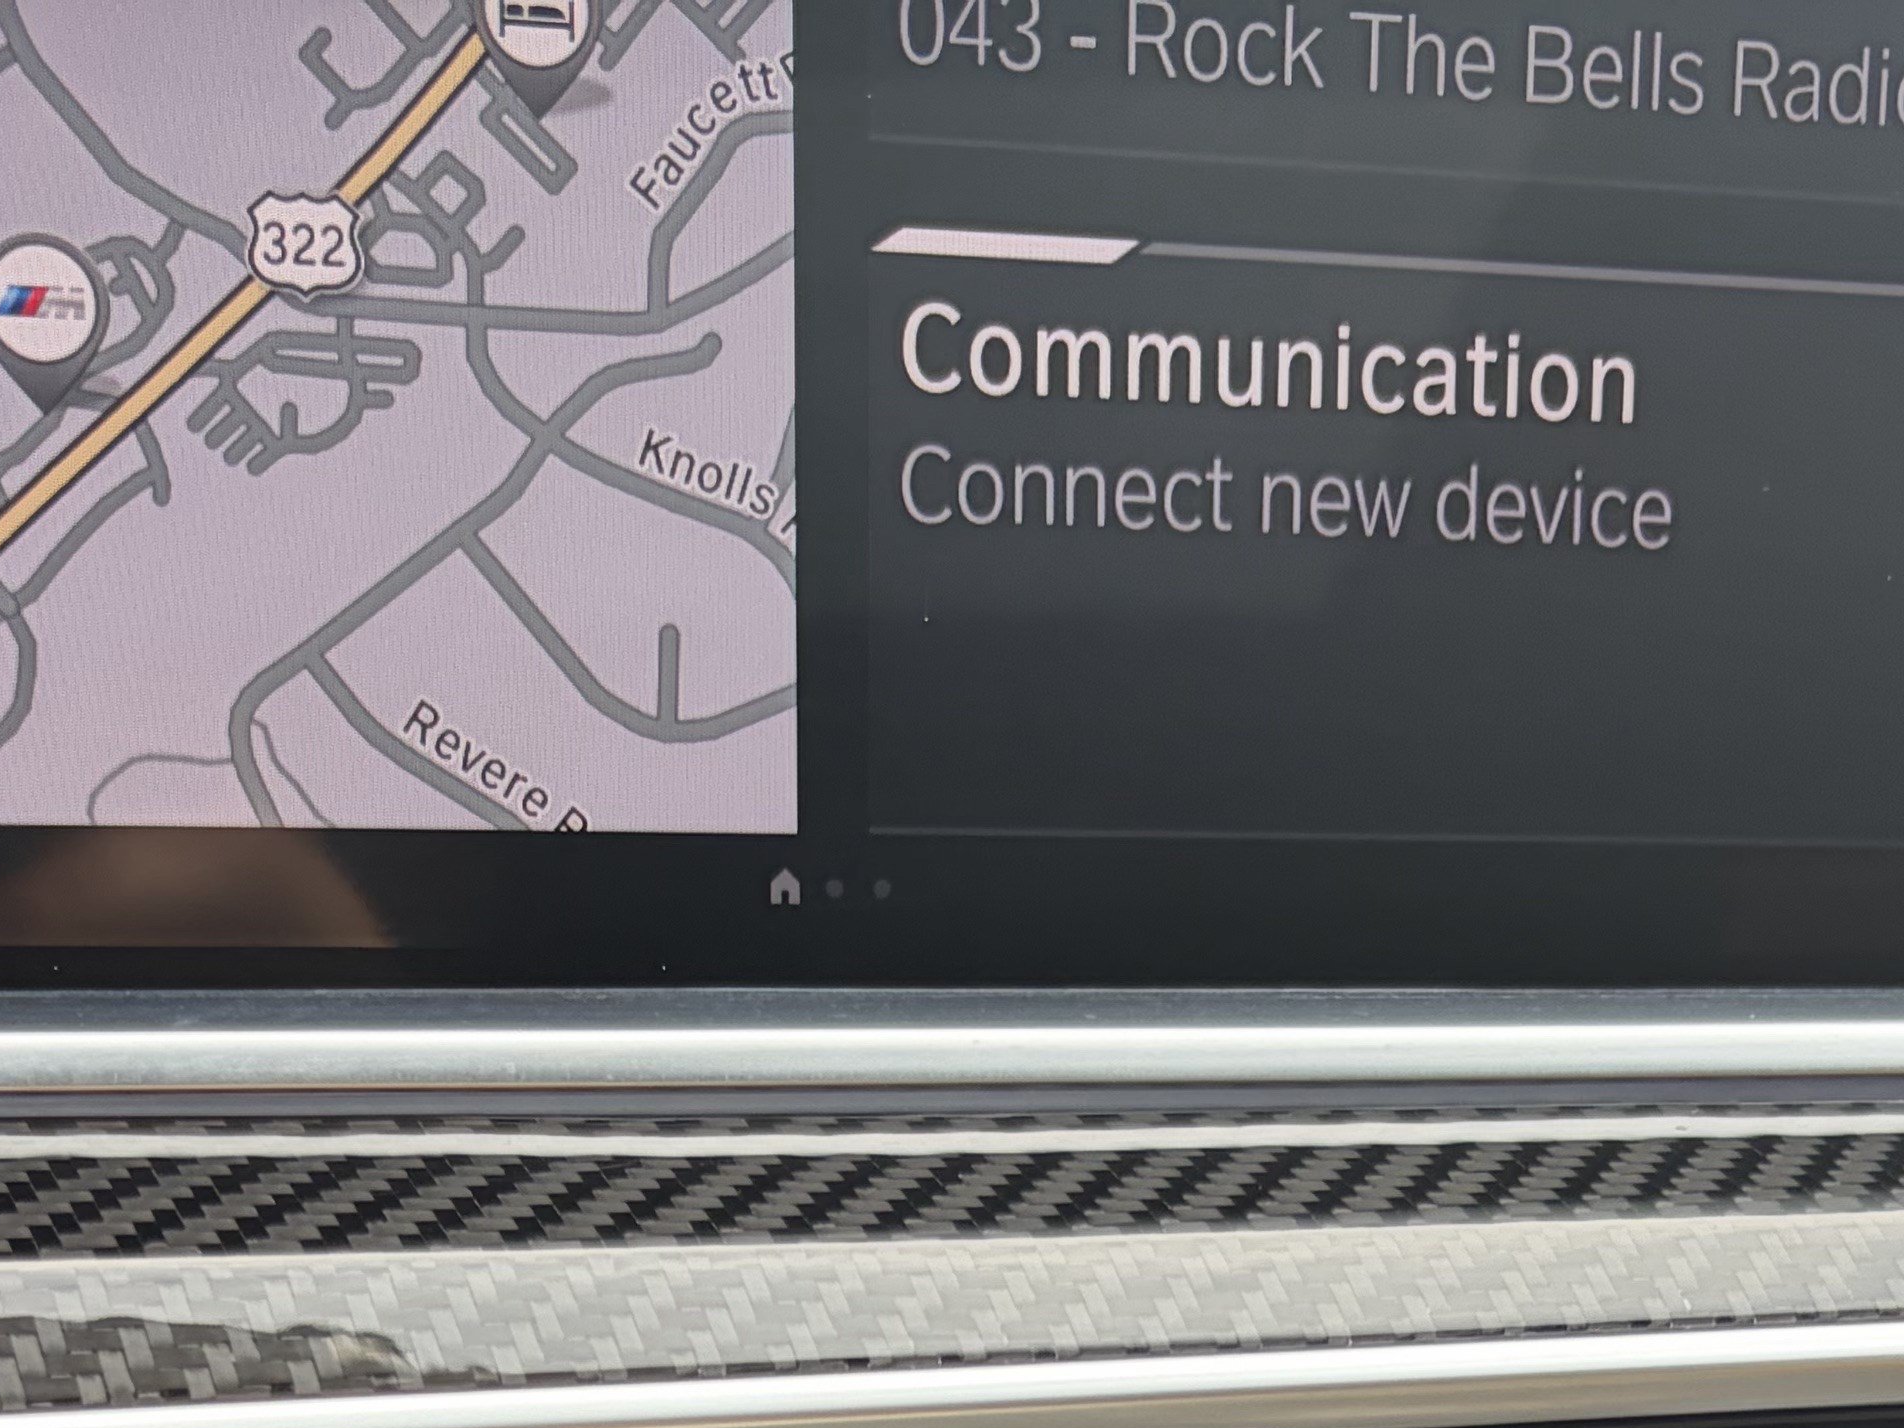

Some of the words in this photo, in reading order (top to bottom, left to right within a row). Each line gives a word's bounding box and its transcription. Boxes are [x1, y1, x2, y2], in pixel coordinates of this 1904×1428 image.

[899, 0, 1042, 72] 043
[1128, 0, 1324, 89] Rock
[1349, 11, 1496, 101] The
[1526, 24, 1704, 115] Bells
[630, 62, 779, 209] Faucett
[262, 223, 347, 269] 322
[902, 301, 1637, 424] Communication
[638, 428, 775, 515] Knolls
[901, 444, 1233, 532] Connect
[1261, 473, 1412, 538] new
[1436, 463, 1672, 550] device
[403, 700, 550, 817] Revere
